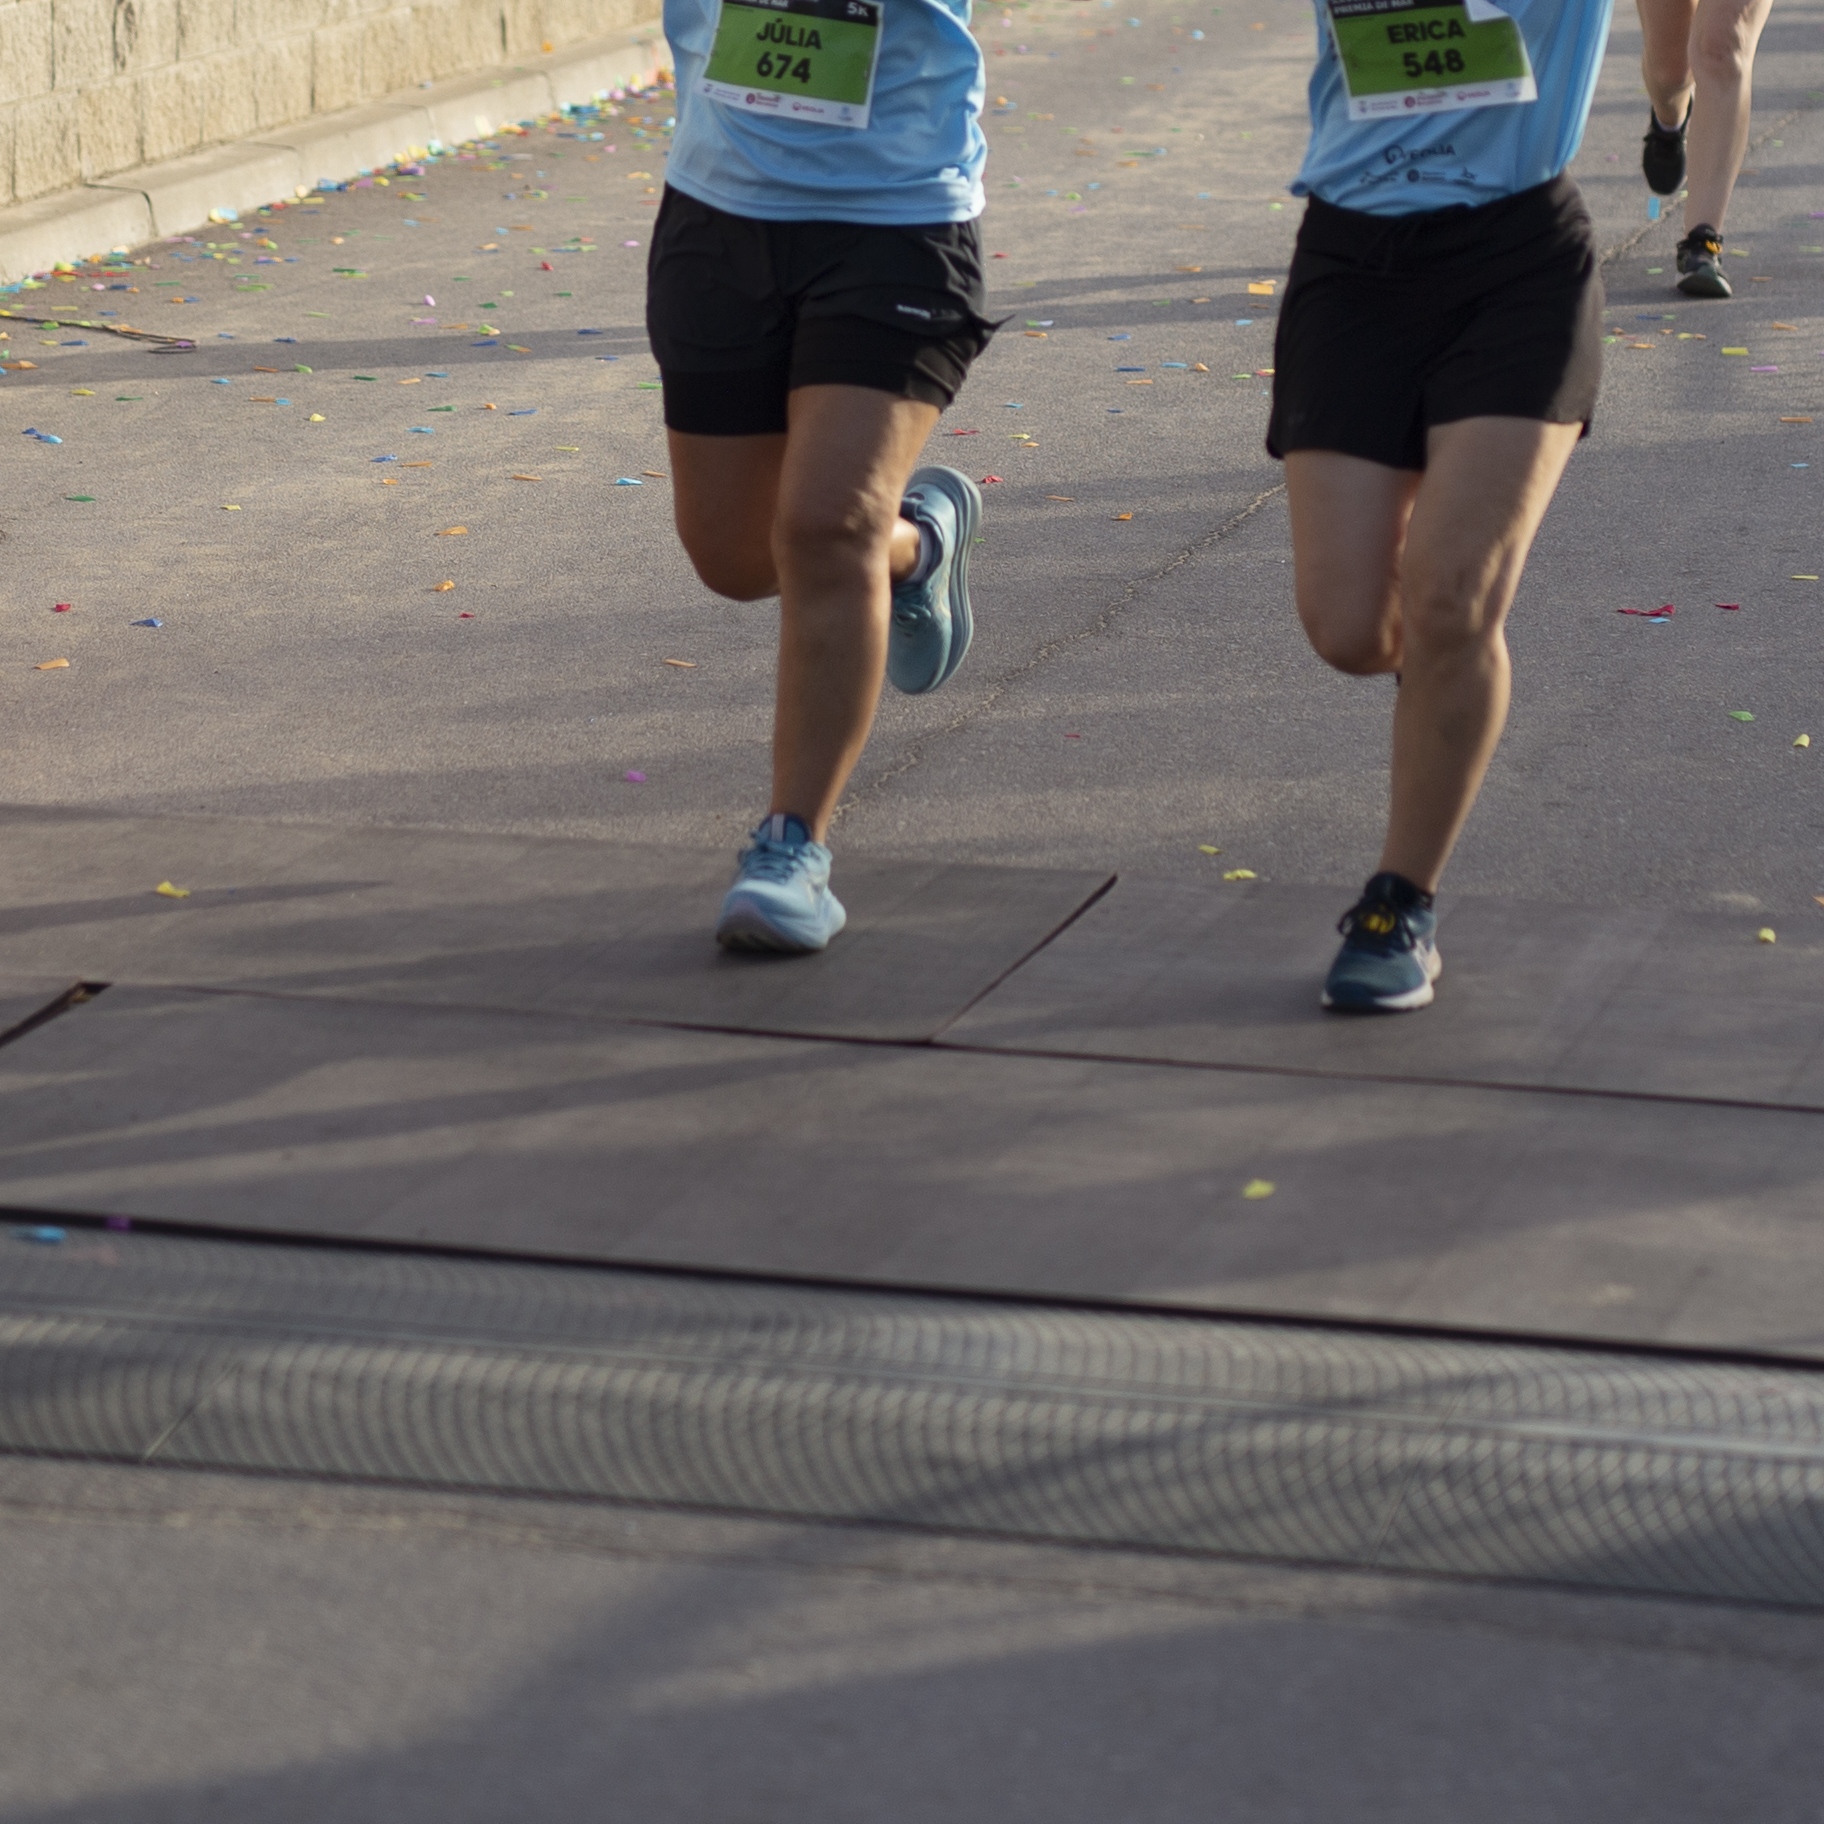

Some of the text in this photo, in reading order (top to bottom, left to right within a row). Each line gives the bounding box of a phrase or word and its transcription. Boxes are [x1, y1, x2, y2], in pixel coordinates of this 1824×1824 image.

[846, 1, 869, 17] 5K
[756, 17, 823, 51] JÚLIA
[1386, 18, 1467, 44] ERICA
[757, 51, 811, 84] 674
[1403, 48, 1466, 79] 548
